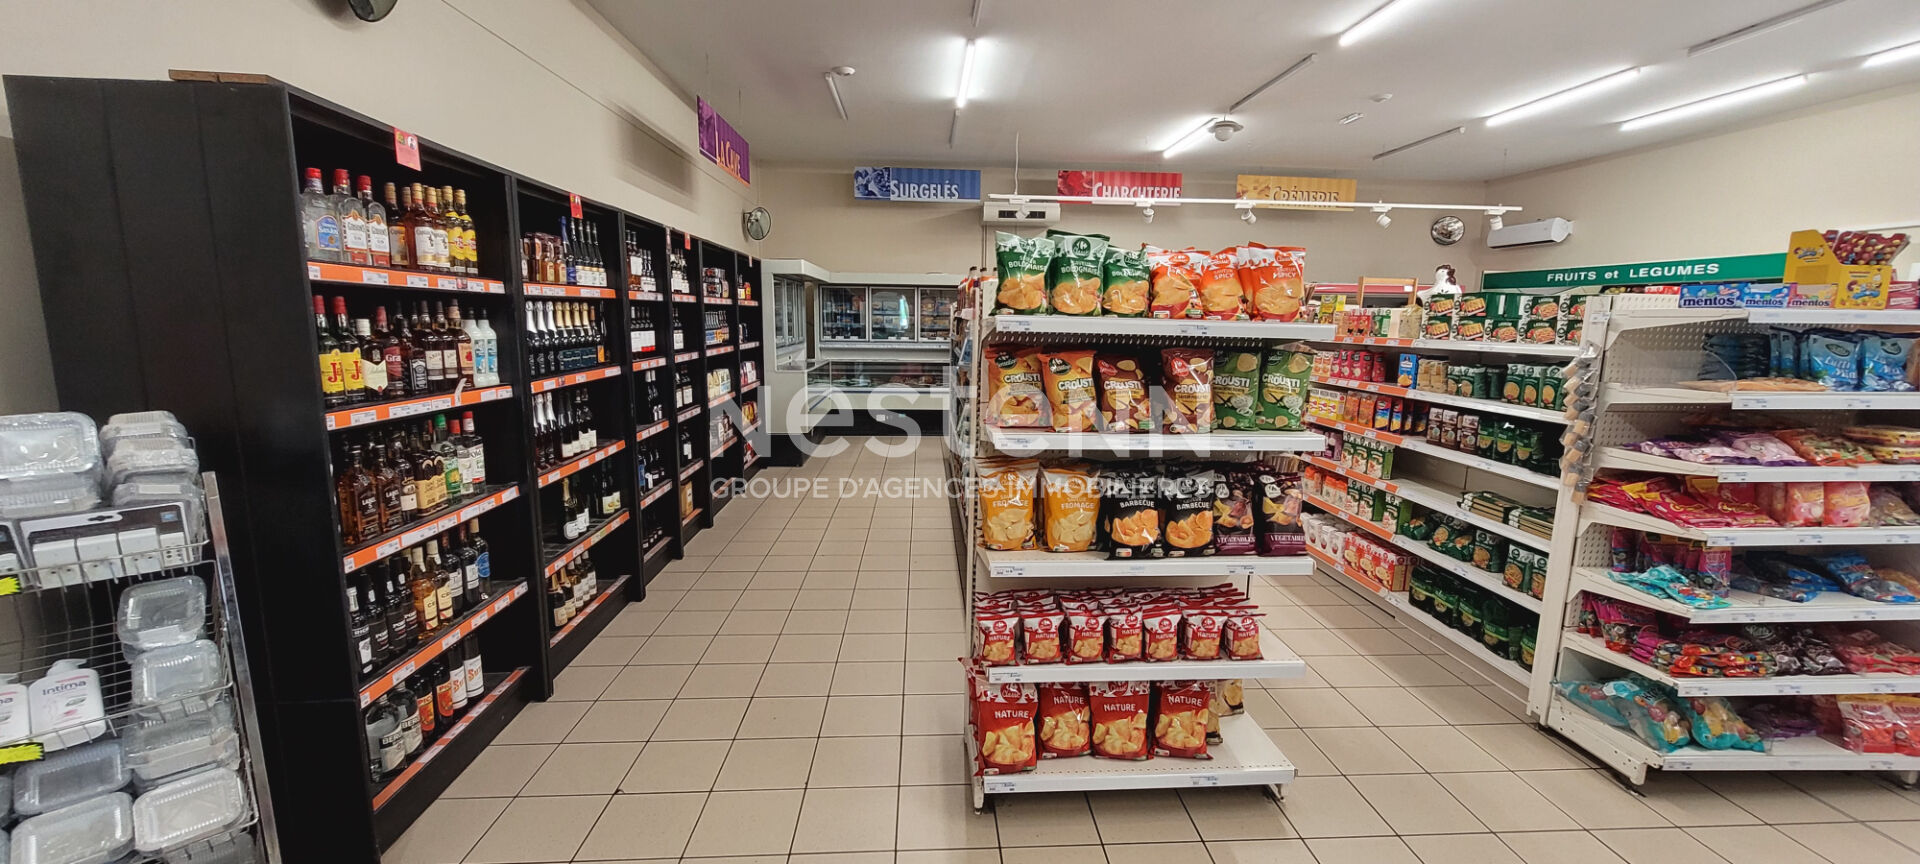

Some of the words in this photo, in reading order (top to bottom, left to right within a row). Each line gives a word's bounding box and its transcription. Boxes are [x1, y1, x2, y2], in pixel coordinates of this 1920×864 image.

[890, 179, 959, 200] SURGELÉS
[1547, 271, 1597, 282] FRUITS
[1604, 270, 1619, 280] et
[1629, 263, 1720, 279] LEGUMES
[1682, 295, 1736, 307] mentos
[1745, 298, 1784, 306] mentos
[1791, 299, 1831, 307] mentos
[1003, 372, 1041, 384] CROUSTI
[1261, 373, 1301, 388] CROUSTI
[1103, 379, 1142, 390] CROUSTI
[992, 499, 1029, 508] FROGE
[1060, 502, 1095, 510] FROMAGE
[1119, 500, 1155, 509] BARBECUE
[1176, 501, 1210, 511] BARBECUE
[42, 680, 87, 696] Intima
[1053, 696, 1085, 705] NATURE
[1168, 695, 1203, 706] NATURE
[1103, 703, 1136, 712] NATURE
[994, 709, 1029, 719] NATURE
